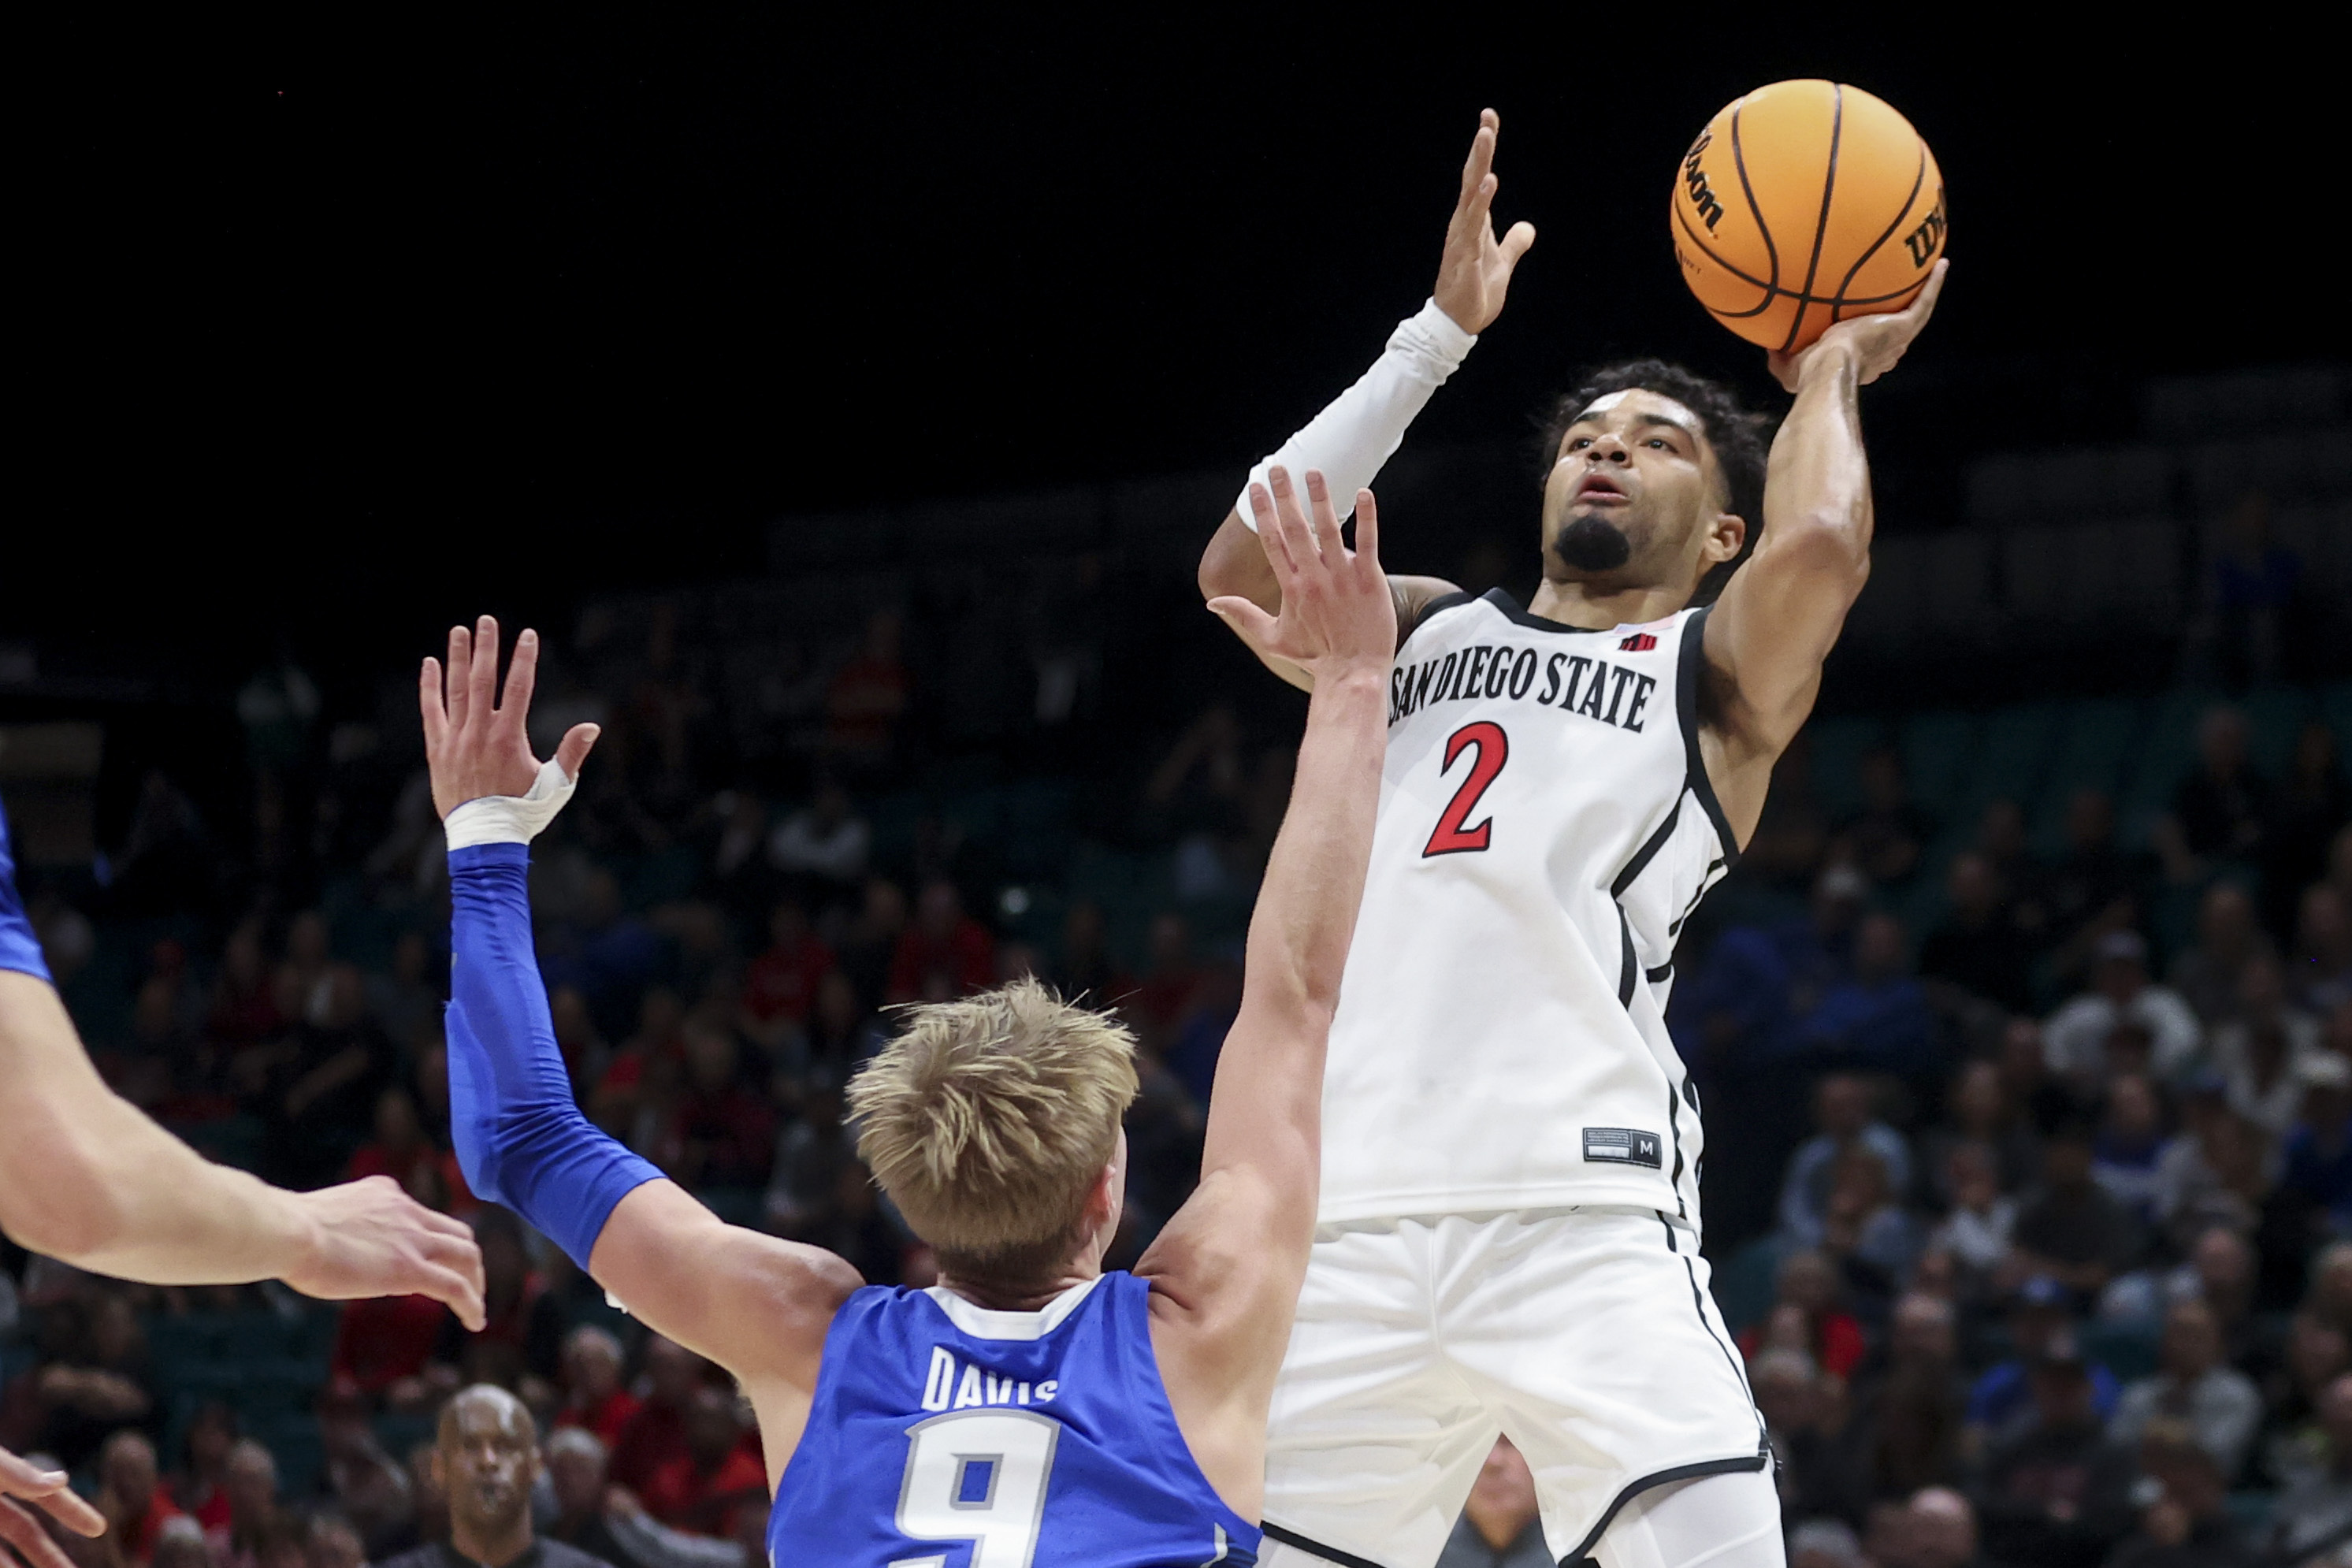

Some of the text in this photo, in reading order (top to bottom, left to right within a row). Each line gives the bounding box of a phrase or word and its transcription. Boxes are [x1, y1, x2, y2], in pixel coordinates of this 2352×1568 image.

[1388, 645, 1657, 734] SAN DIEGO STATE
[1421, 720, 1509, 859] 2
[1640, 1139, 1654, 1157] M
[920, 1345, 1058, 1413] DAVIS
[887, 1407, 1061, 1568] 9
